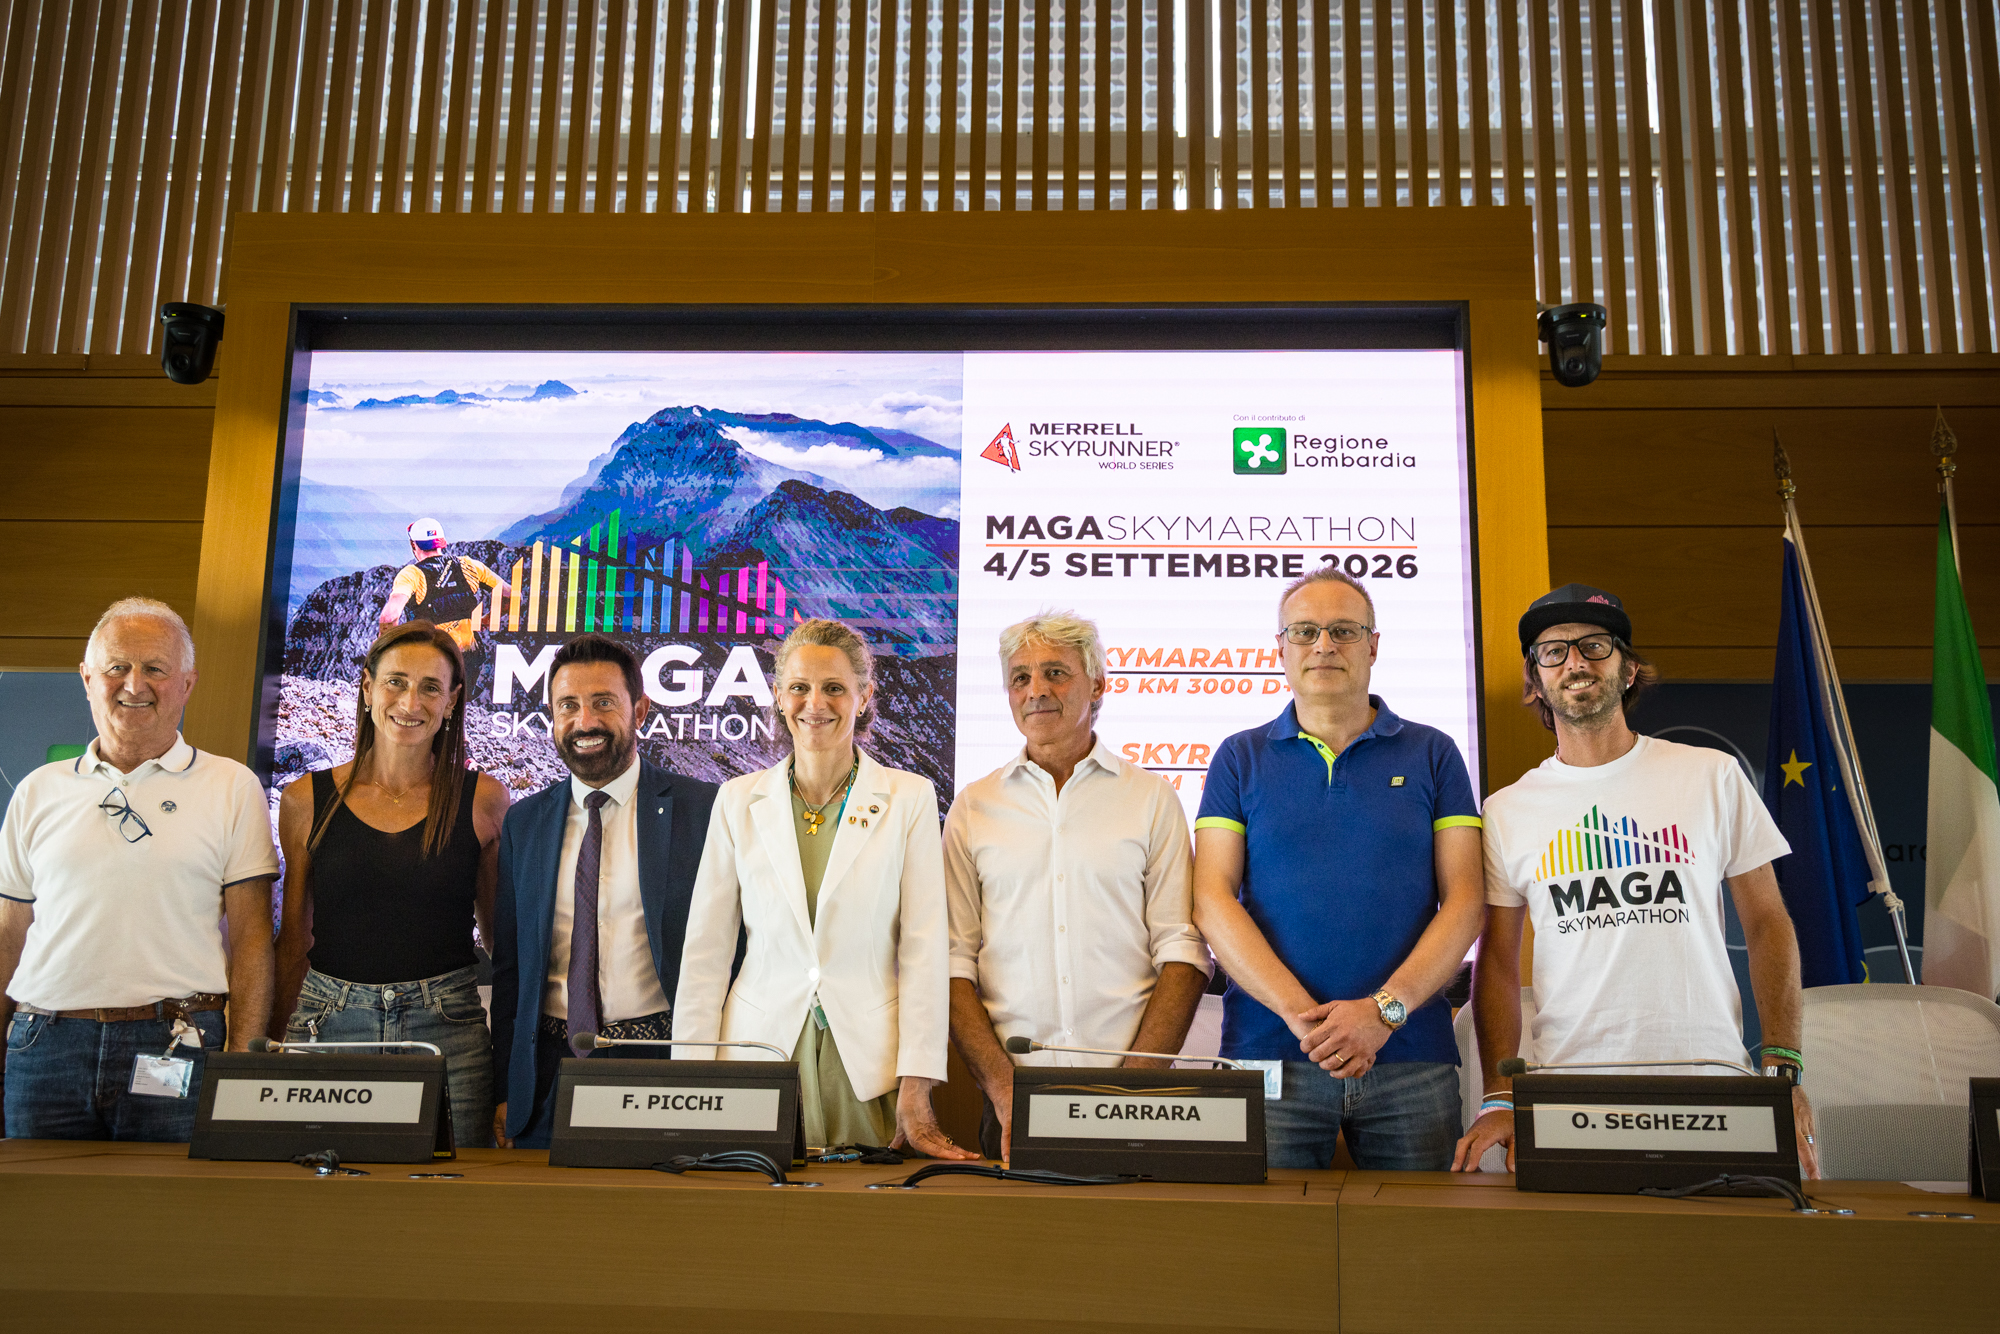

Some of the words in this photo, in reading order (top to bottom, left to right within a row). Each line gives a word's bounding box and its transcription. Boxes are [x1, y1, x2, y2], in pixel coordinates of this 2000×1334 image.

[1232, 414, 1250, 422] Con
[1251, 413, 1256, 422] il
[1257, 413, 1297, 422] contributo
[1298, 413, 1306, 422] di
[1029, 422, 1143, 436] MERRELL
[1293, 434, 1389, 454] Regione
[1098, 461, 1137, 470] WORLD
[1139, 461, 1174, 470] SERIES
[1293, 452, 1417, 468] Lombardia
[983, 548, 1051, 582] 4/5
[1066, 552, 1304, 579] SETTEMBRE
[492, 644, 775, 707] MGA
[1137, 677, 1180, 694] KM
[1186, 678, 1253, 695] 3000
[490, 711, 776, 741] SKYATHON
[1121, 742, 1211, 765] SKYR
[1548, 869, 1687, 917] MAGA
[1557, 908, 1690, 934] SKYMARATHON
[259, 1087, 278, 1103] P.
[286, 1087, 373, 1105] FRANCO
[622, 1094, 639, 1110] F.
[647, 1094, 724, 1111] PICCHI
[1068, 1103, 1087, 1119] E.
[1094, 1103, 1201, 1121] CARRARA
[1571, 1112, 1597, 1129] O.
[1604, 1113, 1728, 1132] SEGHEZZI
